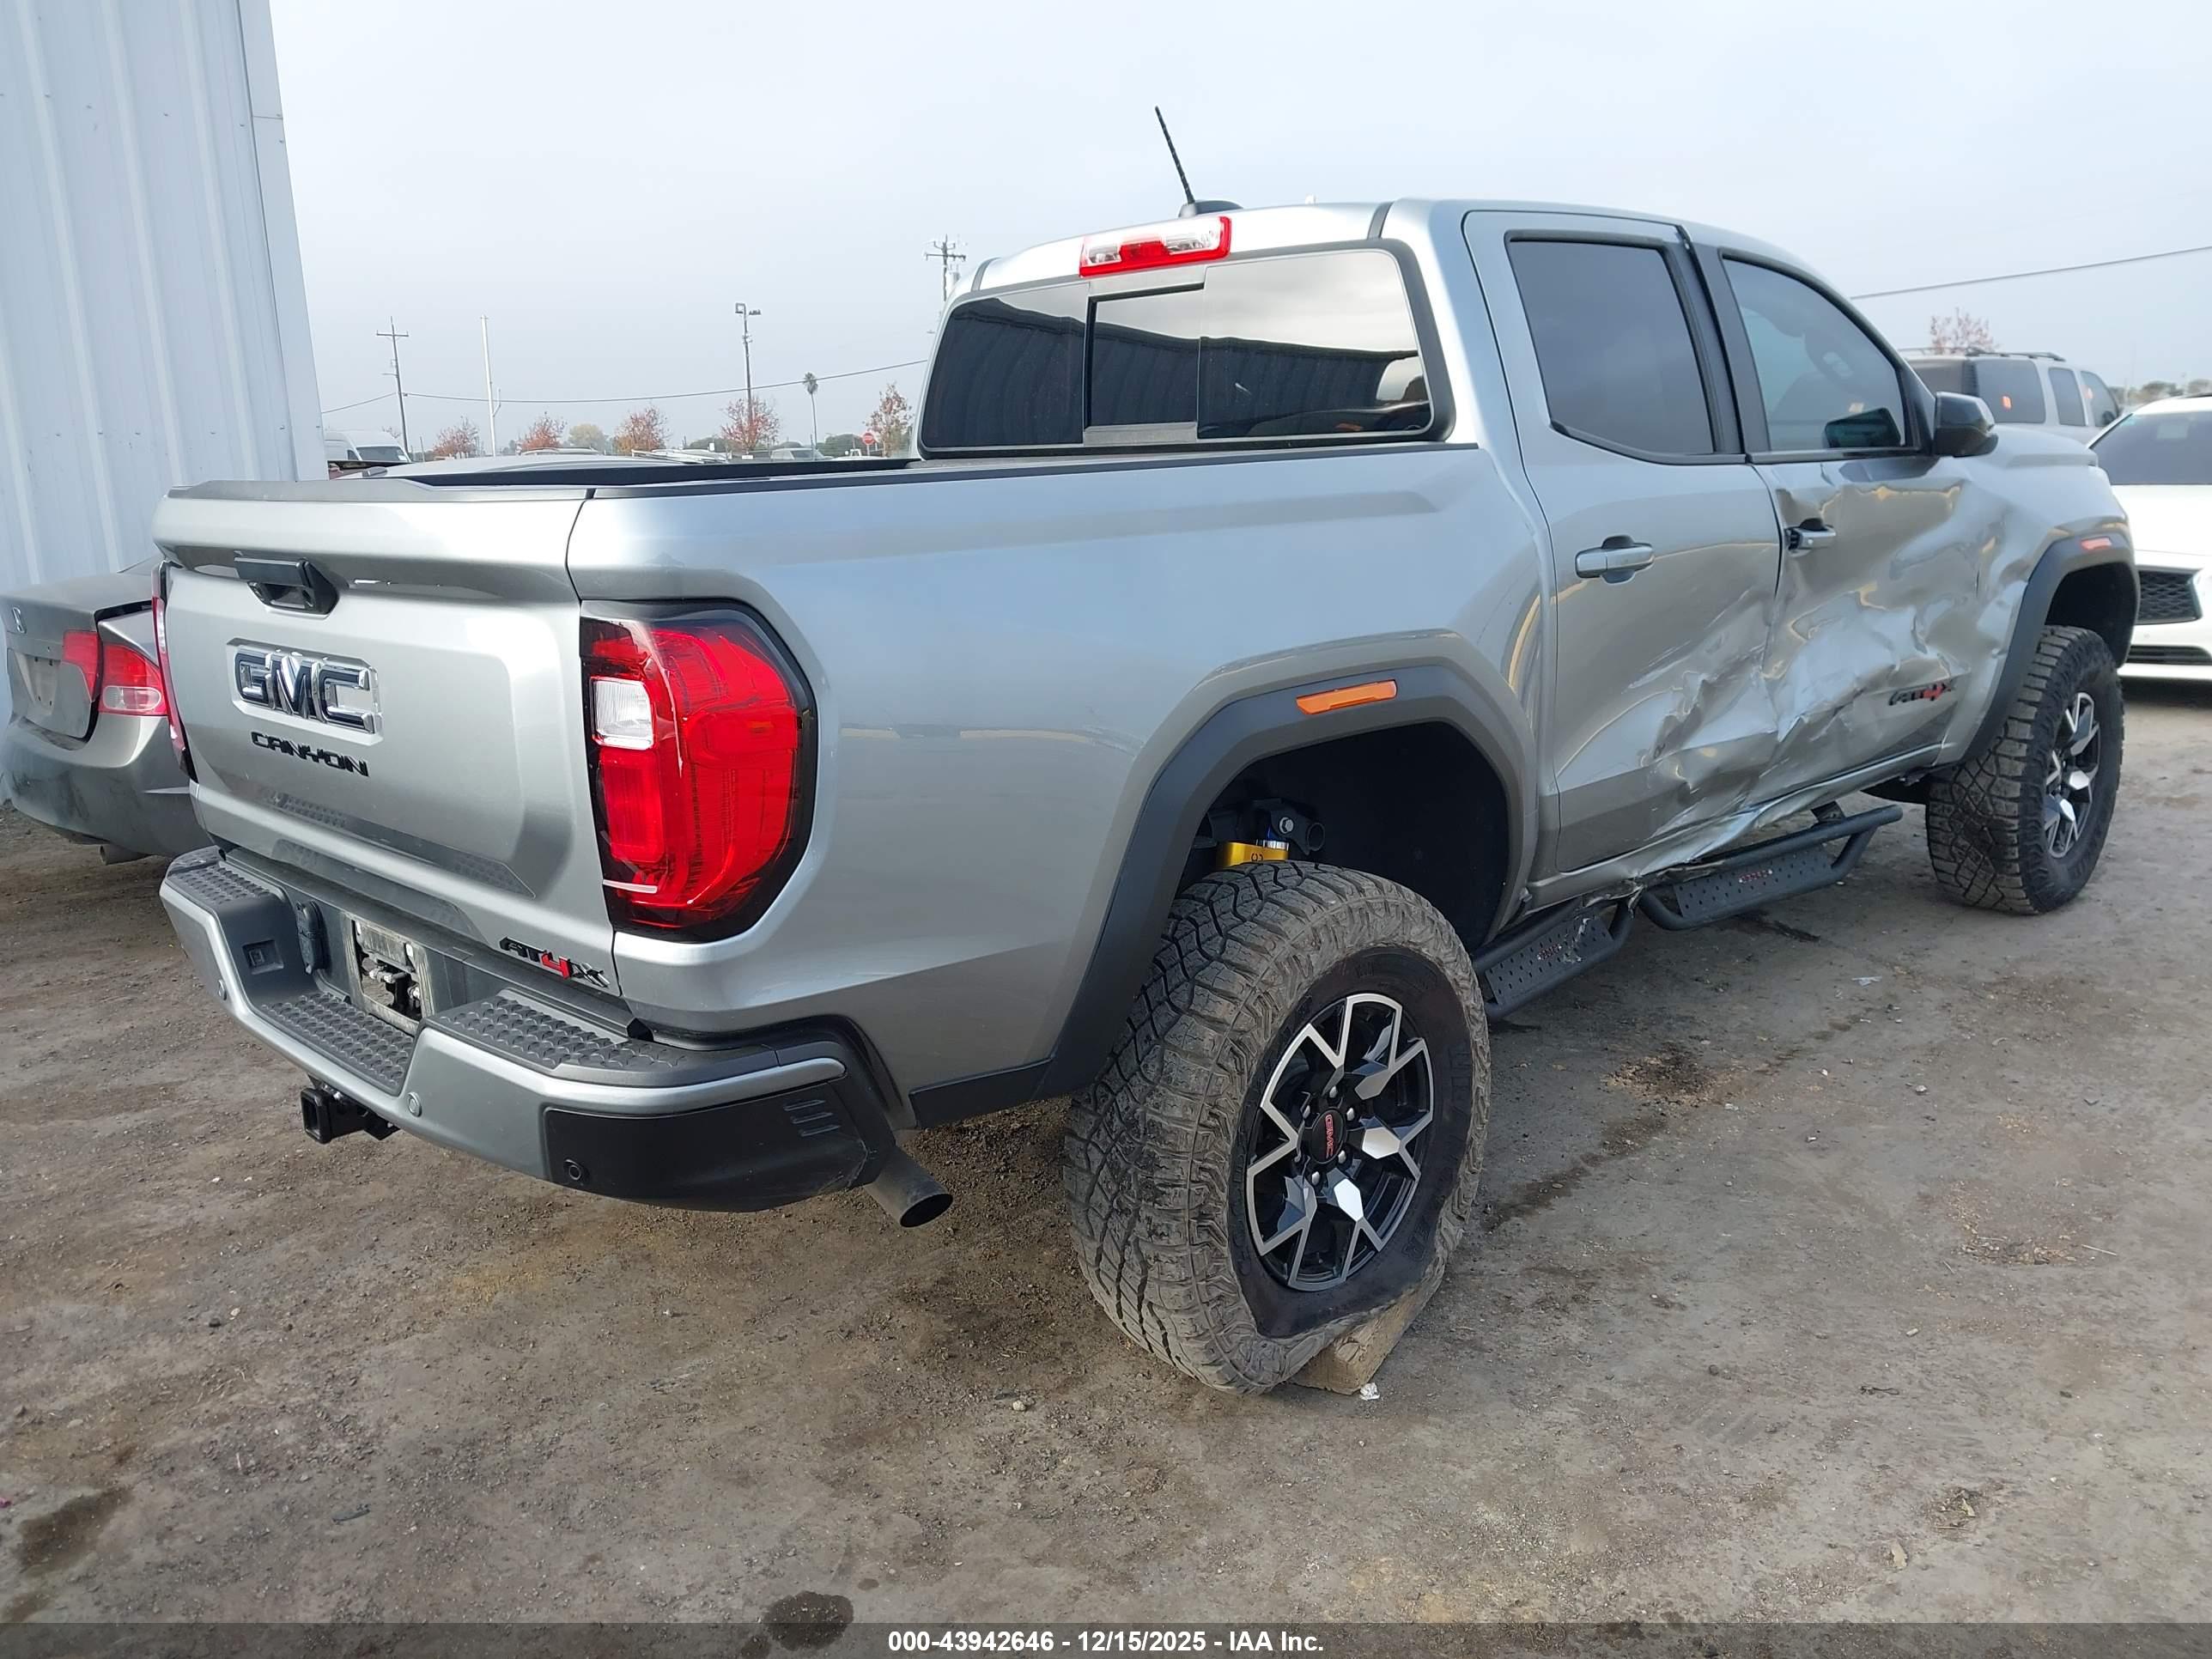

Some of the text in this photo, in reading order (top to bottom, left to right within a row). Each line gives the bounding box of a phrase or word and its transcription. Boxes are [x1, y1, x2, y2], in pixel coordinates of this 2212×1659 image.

[234, 647, 379, 735] GMC
[251, 731, 370, 777] CANYON
[1324, 1114, 1335, 1159] GMC
